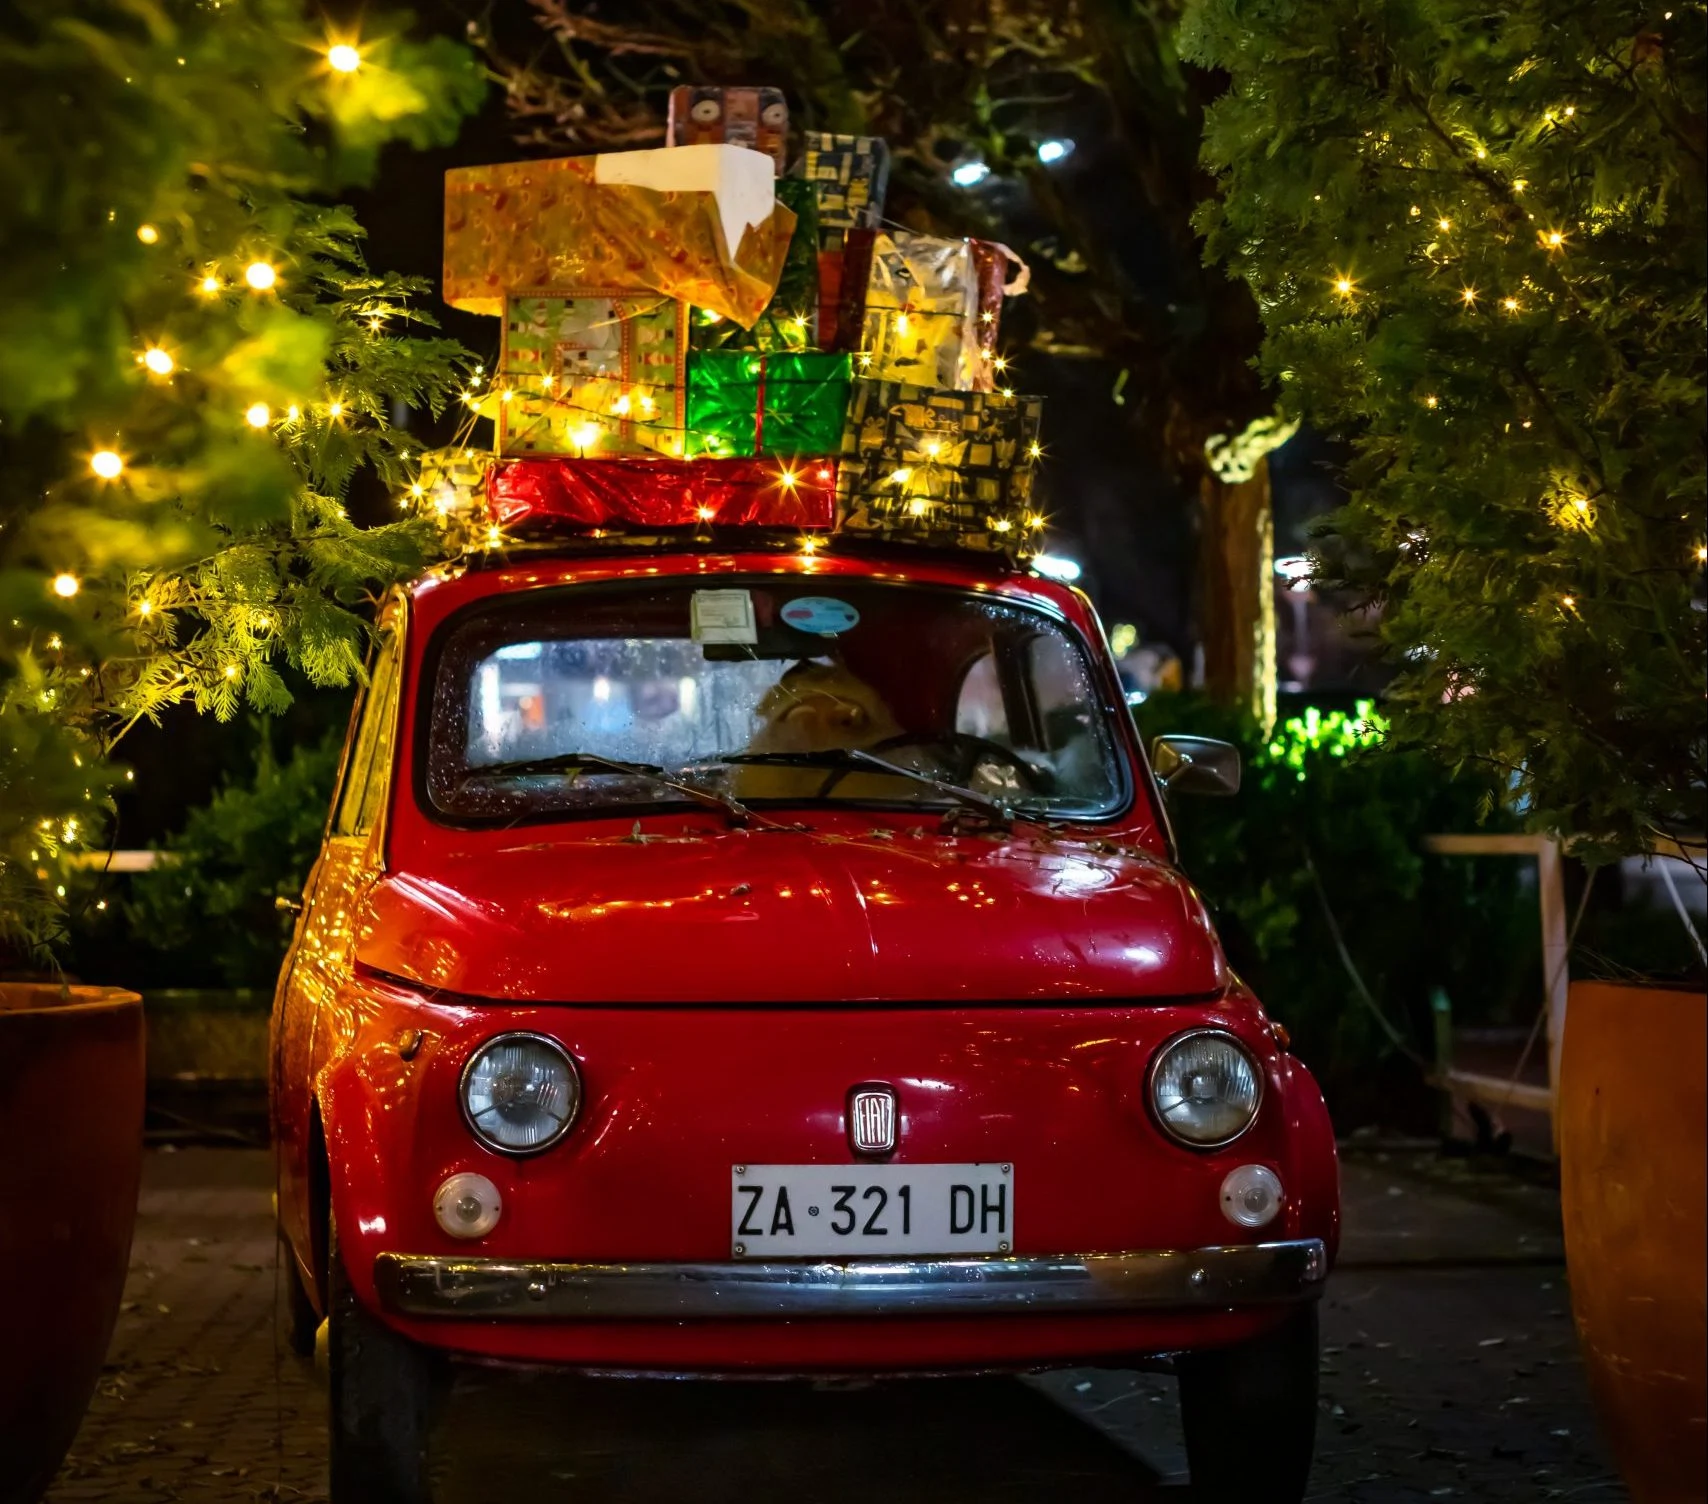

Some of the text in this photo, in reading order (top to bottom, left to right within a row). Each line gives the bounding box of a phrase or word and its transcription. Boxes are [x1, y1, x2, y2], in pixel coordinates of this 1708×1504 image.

[858, 1097, 886, 1144] FIAT
[737, 1183, 1006, 1236] ZA 321 DH
